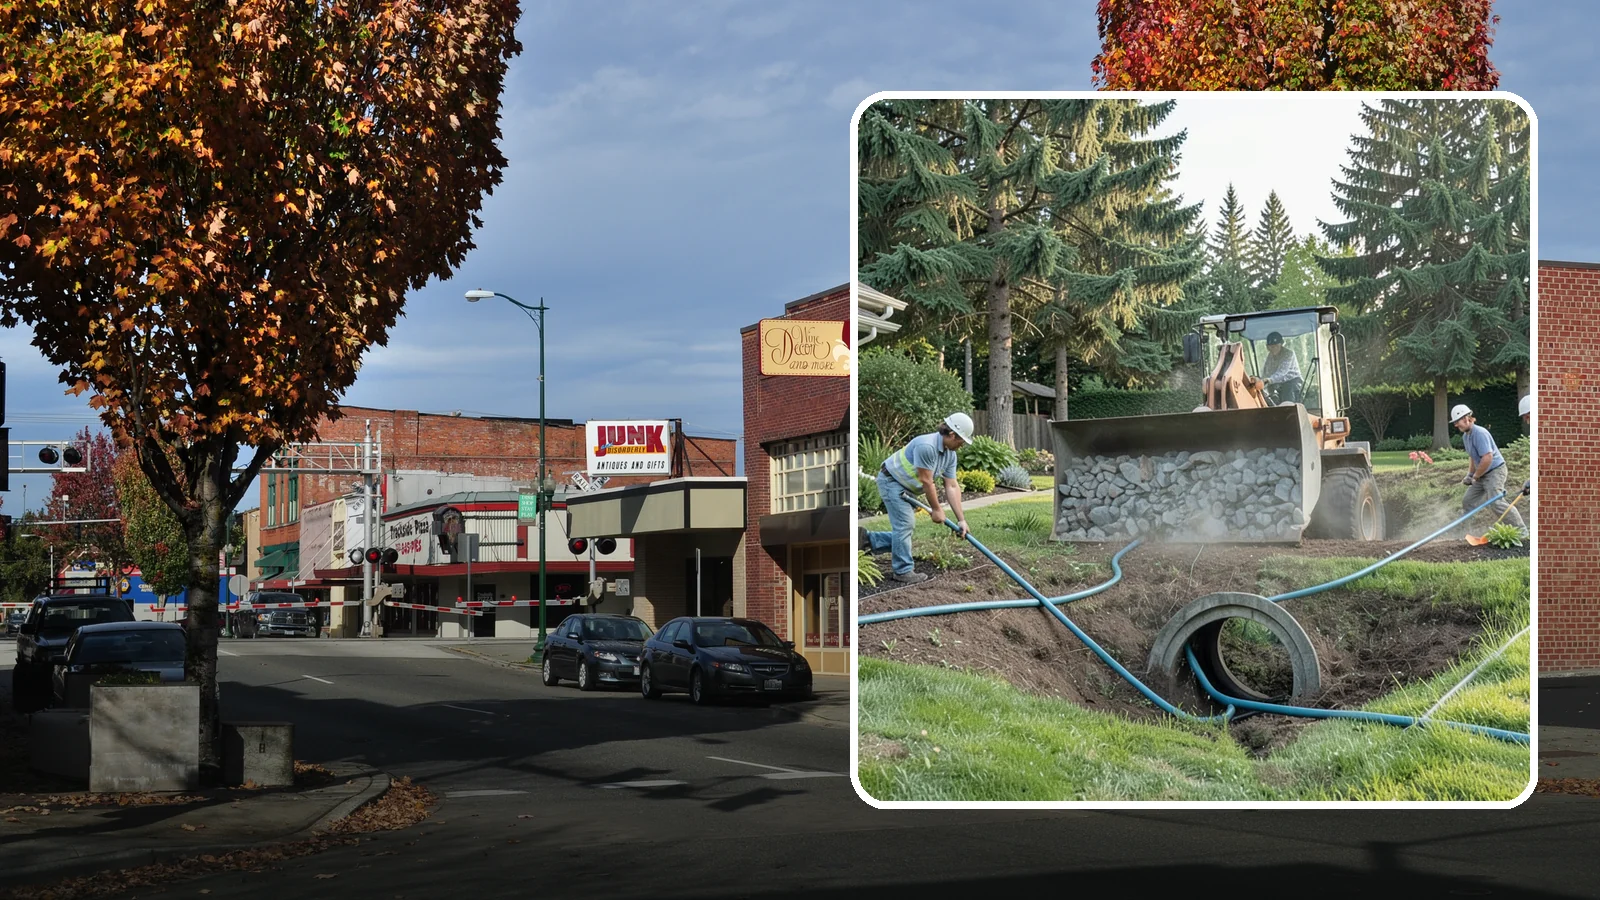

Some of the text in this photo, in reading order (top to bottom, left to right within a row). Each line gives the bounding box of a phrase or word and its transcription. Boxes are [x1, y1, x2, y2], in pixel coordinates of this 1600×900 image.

[765, 328, 830, 365] Decor
[595, 425, 665, 457] JUNK
[607, 446, 646, 454] DISORDERLY
[597, 461, 665, 470] ANTIQUES AND GIFTS
[390, 520, 429, 539] Trackside Pizza
